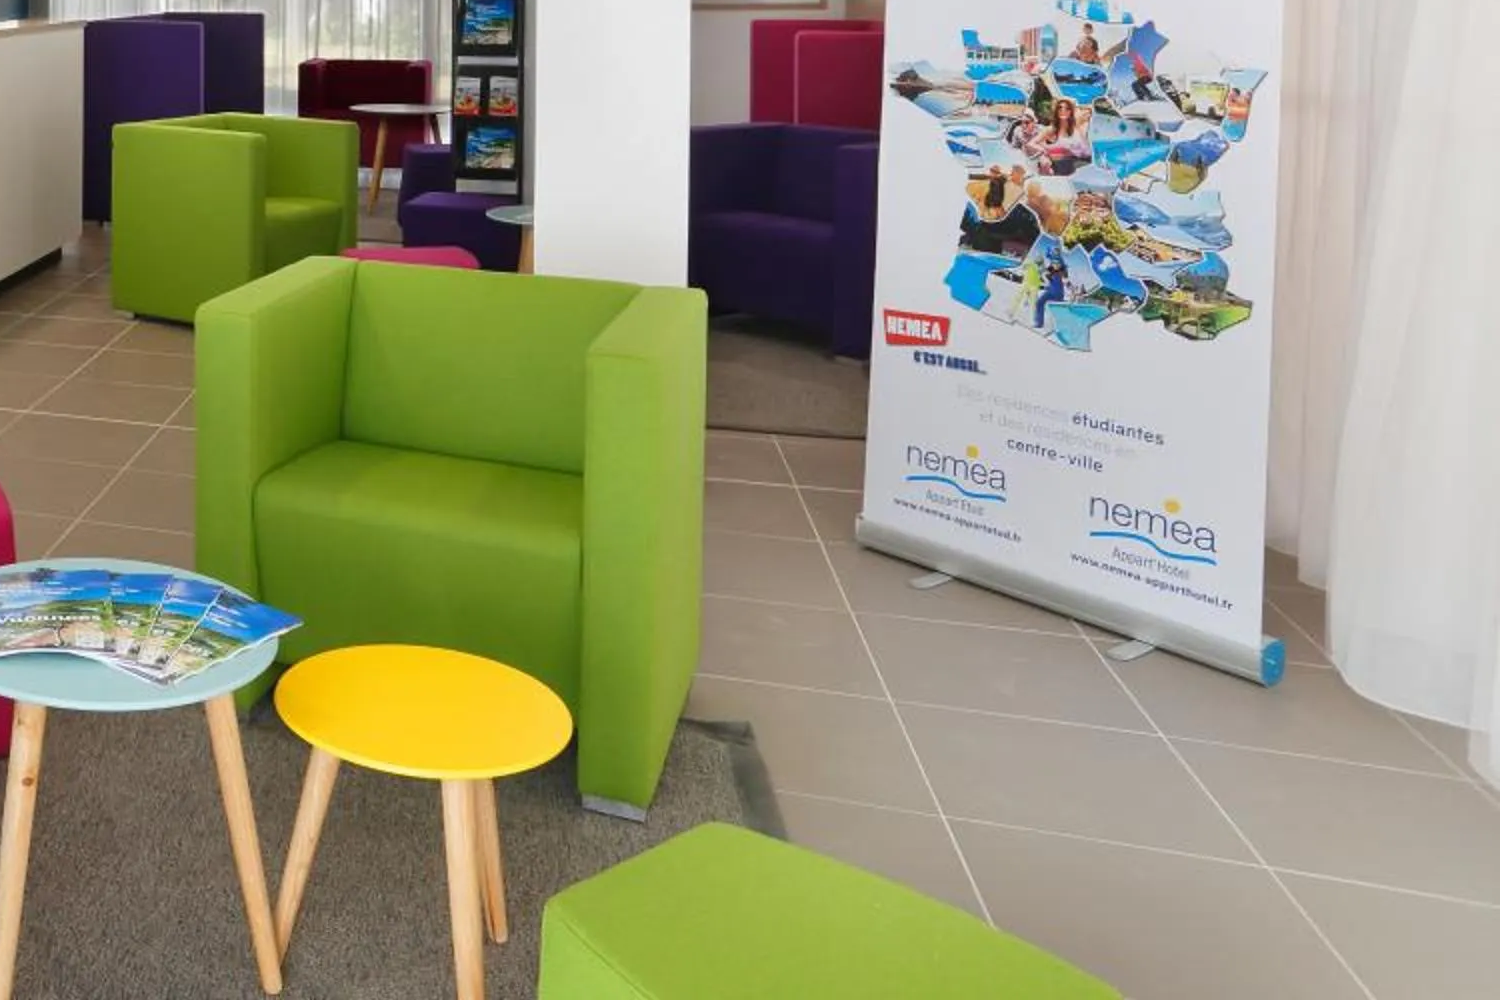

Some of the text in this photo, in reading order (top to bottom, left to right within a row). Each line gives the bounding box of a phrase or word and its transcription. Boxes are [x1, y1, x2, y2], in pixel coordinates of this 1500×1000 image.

[886, 314, 943, 342] NEMEA
[1072, 410, 1166, 447] étudiantes
[906, 444, 1007, 492] nemea
[1006, 437, 1104, 474] centre-ville
[1088, 495, 1217, 554] nemea
